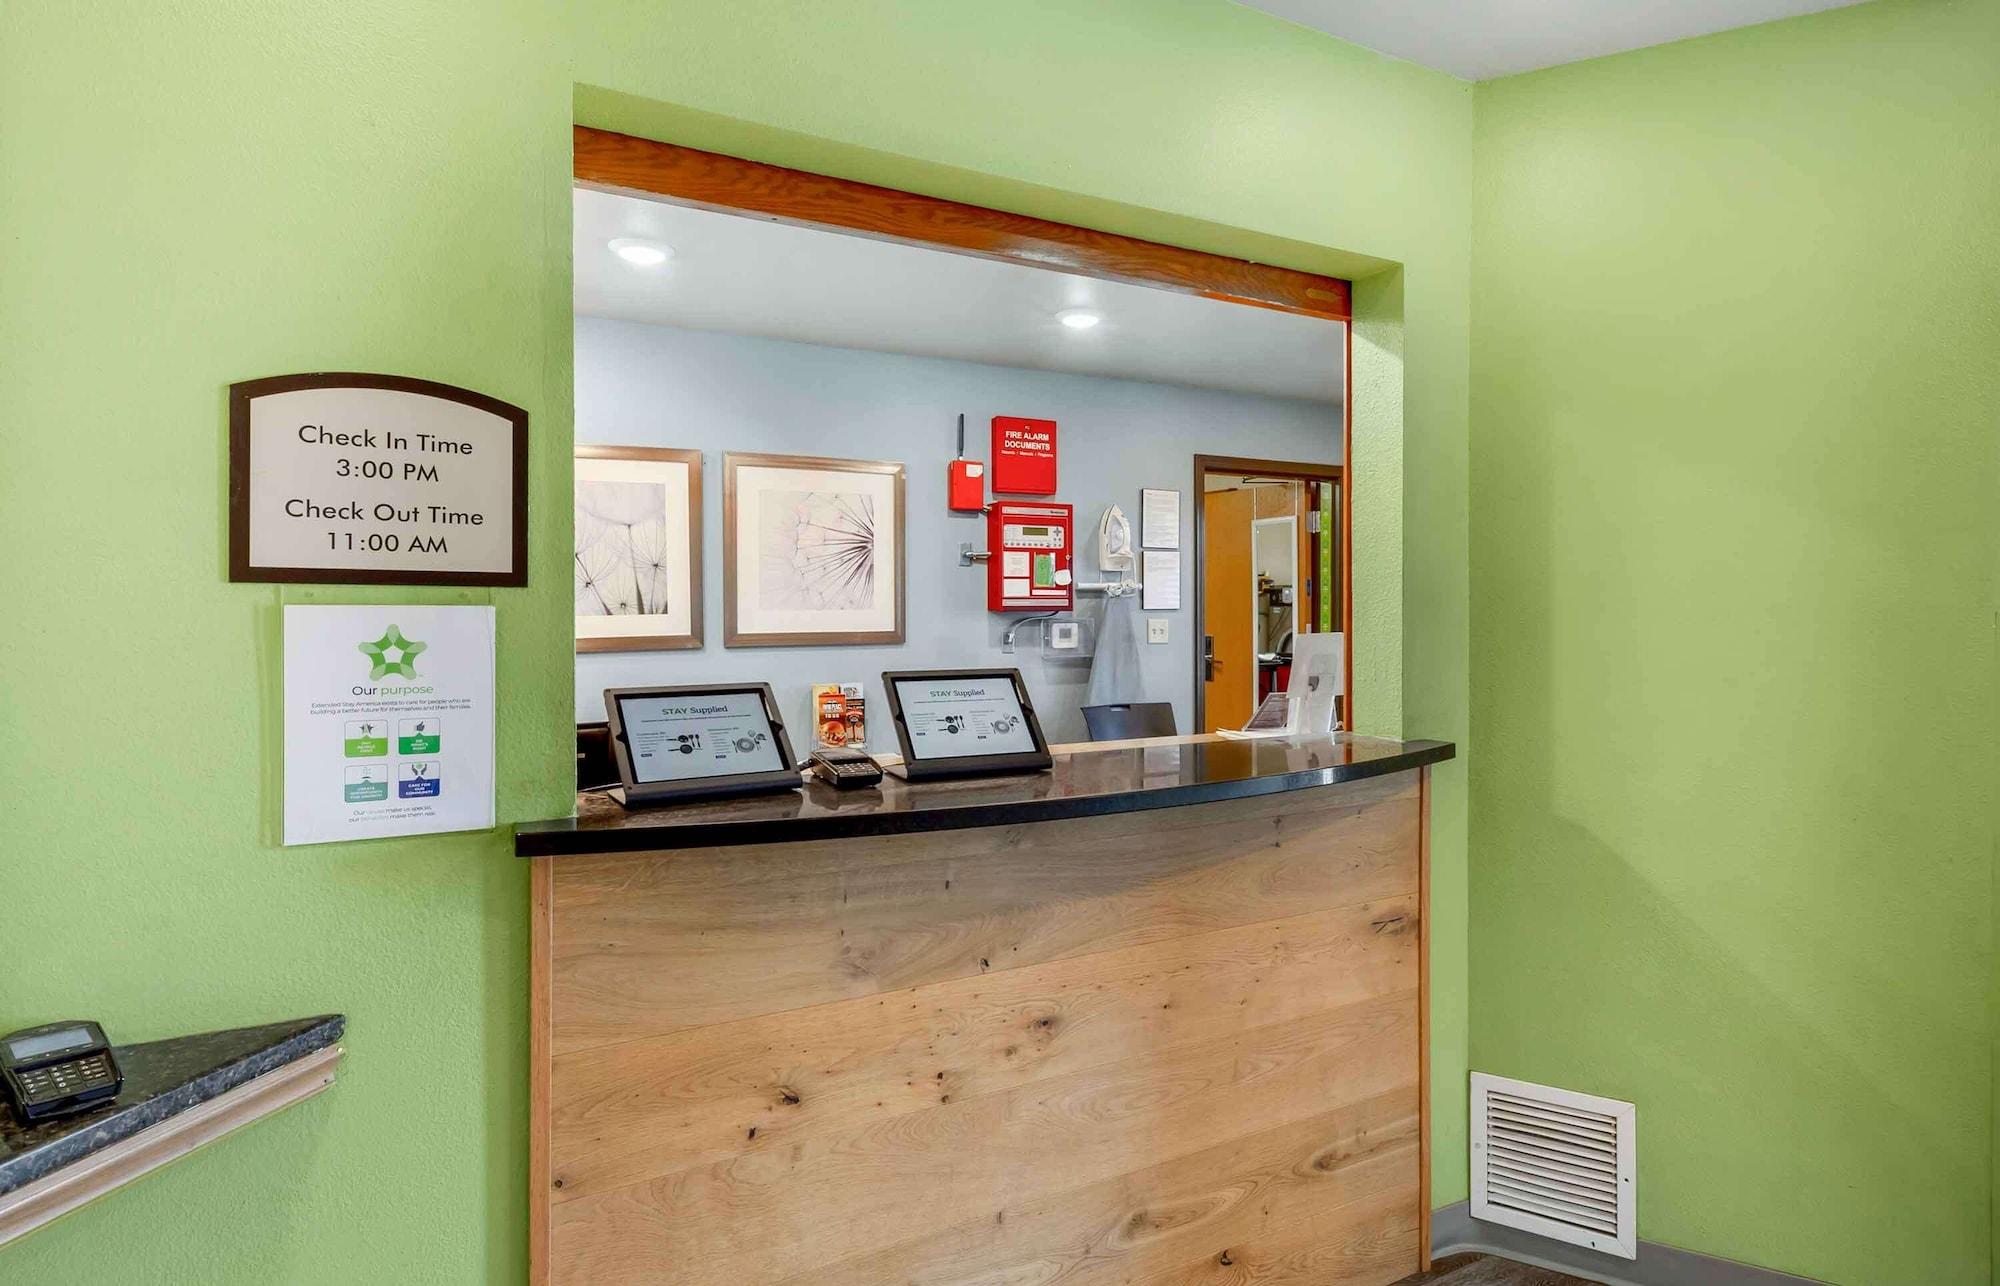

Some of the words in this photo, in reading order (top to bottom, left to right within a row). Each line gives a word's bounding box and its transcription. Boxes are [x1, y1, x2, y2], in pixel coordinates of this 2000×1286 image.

[298, 425, 377, 448] Check
[387, 432, 408, 450] In
[416, 434, 473, 455] Time
[1005, 430, 1022, 439] FIRE
[1023, 432, 1049, 441] ALARM
[1004, 440, 1050, 450] DOCUMENTS
[336, 459, 394, 480] 3:00
[404, 463, 439, 482] PM
[285, 499, 364, 520] Check
[373, 504, 420, 522] Out
[428, 506, 484, 525] Time
[328, 532, 400, 552] 11:00
[408, 535, 448, 553] AM
[352, 685, 378, 696] Our
[380, 685, 434, 698] purpose
[930, 689, 952, 698] STAY
[953, 688, 985, 698] Supplied
[661, 707, 687, 716] STAY
[690, 705, 728, 716] Supplied
